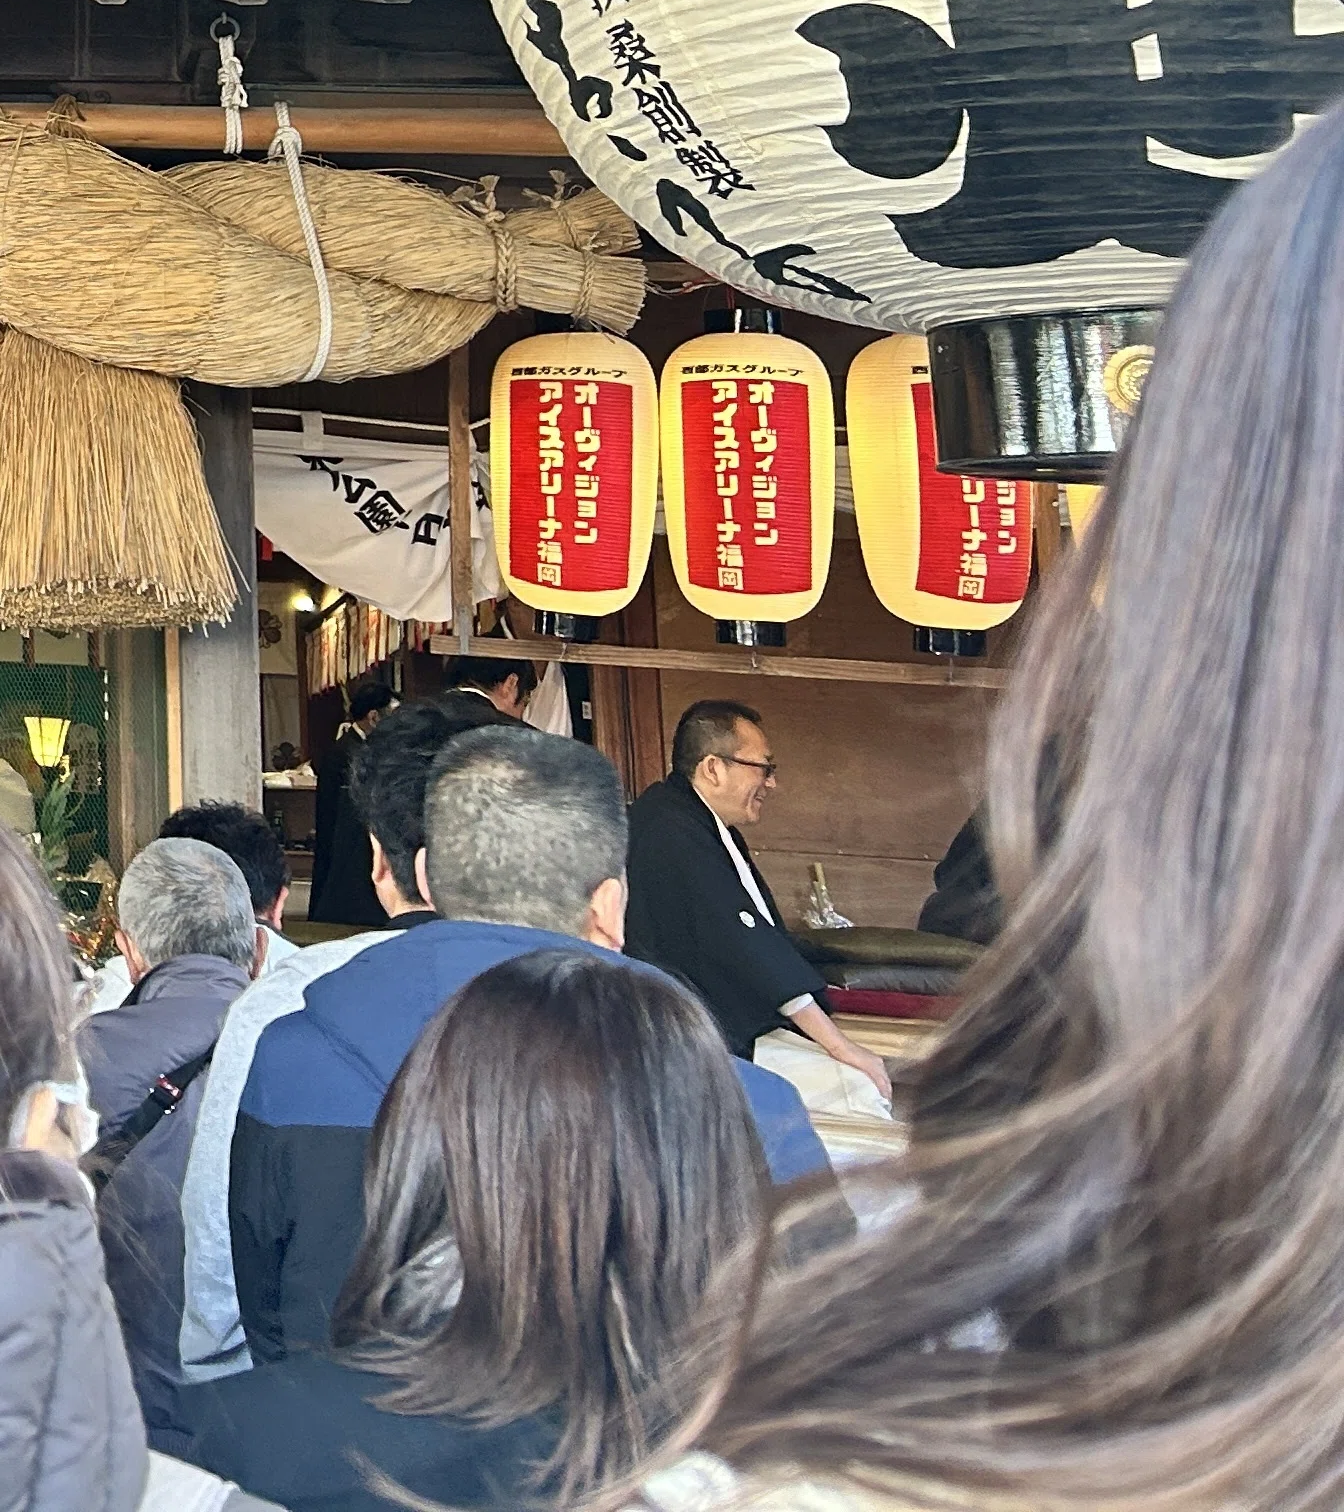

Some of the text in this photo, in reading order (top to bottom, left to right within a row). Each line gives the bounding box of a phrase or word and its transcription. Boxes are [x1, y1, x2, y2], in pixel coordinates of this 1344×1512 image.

[537, 380, 565, 587] アイスアリーナ福岡
[573, 381, 602, 545] オーヴィジョン
[712, 380, 744, 591] アイスアリーナ福岡
[748, 380, 779, 546] オーヴィジョン
[957, 477, 988, 600] リーナ福岡
